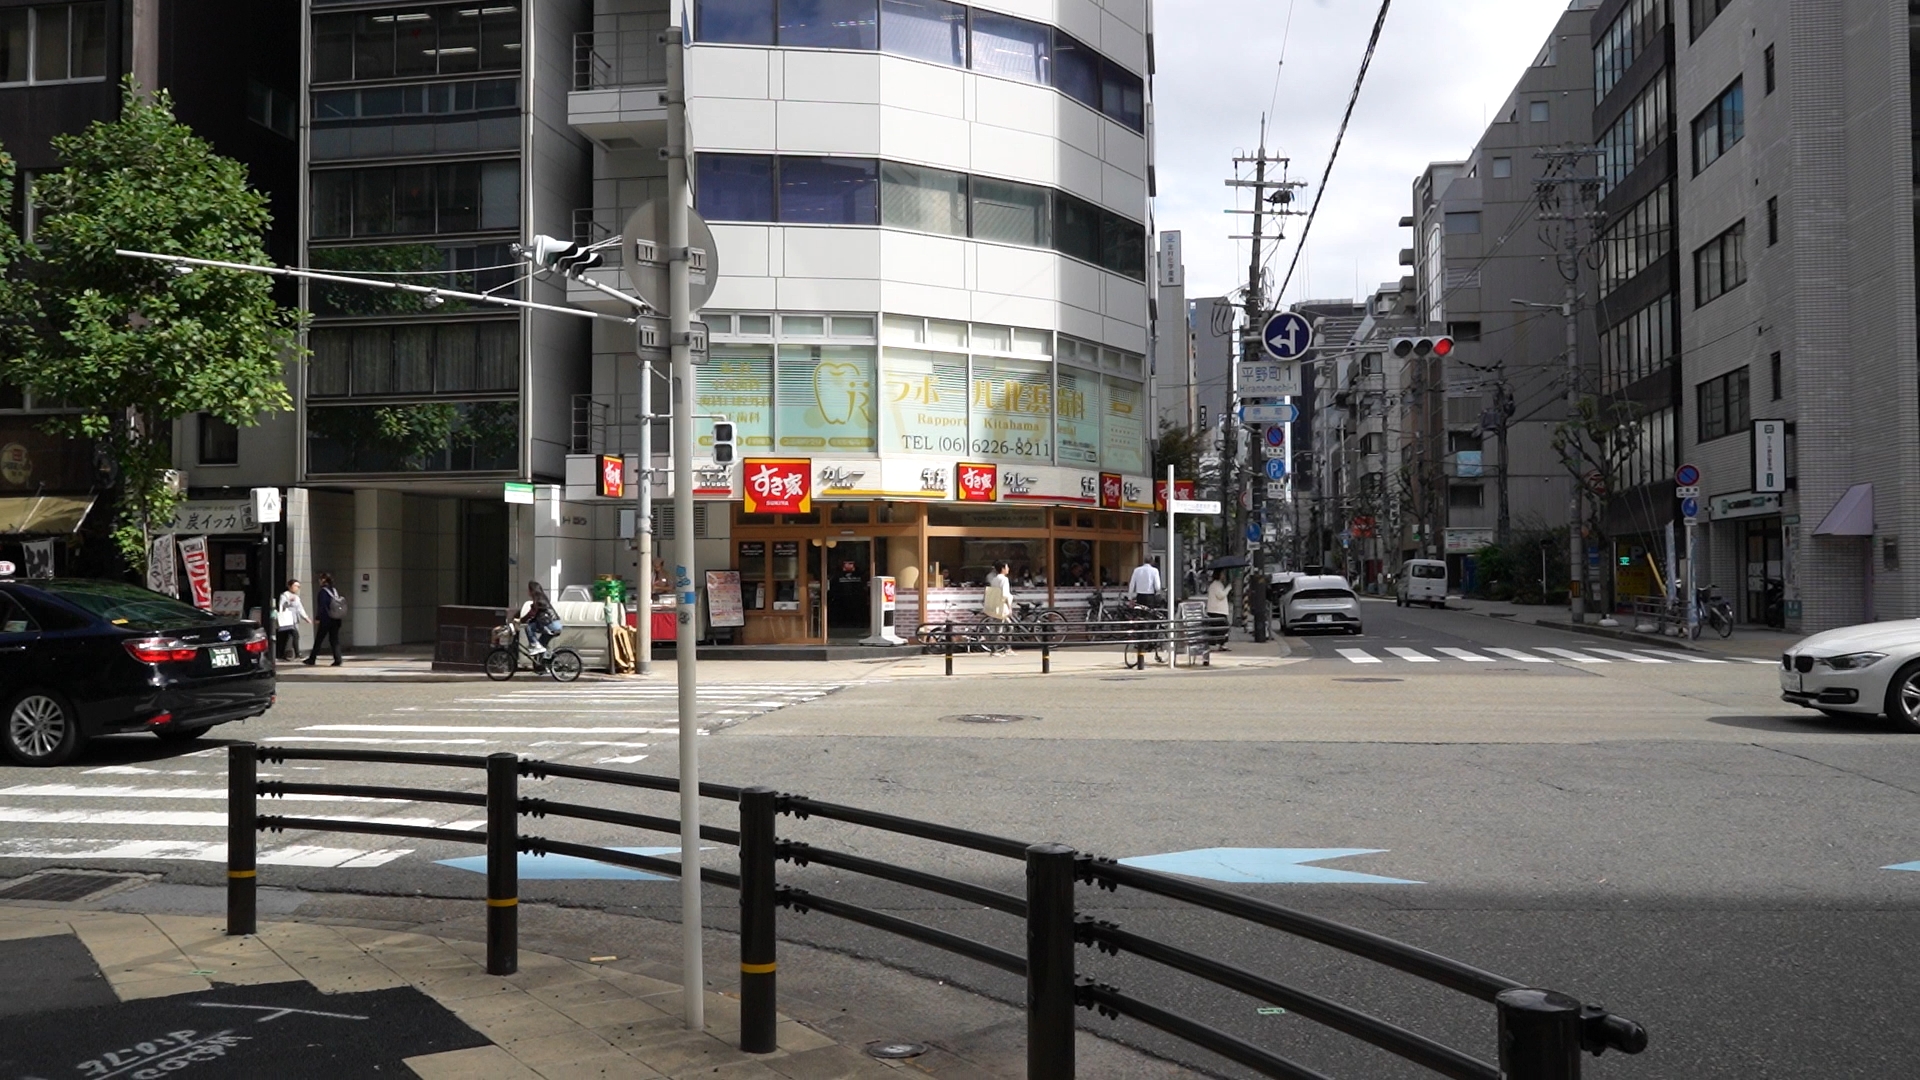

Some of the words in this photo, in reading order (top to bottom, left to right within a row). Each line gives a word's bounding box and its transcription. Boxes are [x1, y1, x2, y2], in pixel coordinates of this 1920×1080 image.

[1241, 366, 1281, 382] 平野町
[1285, 365, 1292, 381] 1
[1240, 384, 1297, 393] Hiranomachi-1
[984, 417, 1040, 432] Kitahama
[902, 435, 934, 451] TEL
[938, 436, 966, 454] (06)
[971, 438, 1050, 458] 6226-8211
[823, 465, 866, 481] カレー
[922, 467, 948, 485] 牛丼
[963, 467, 993, 491] すき家
[1004, 471, 1038, 486] カレー
[751, 464, 803, 500] すき家
[185, 512, 236, 530] 炭イッカ
